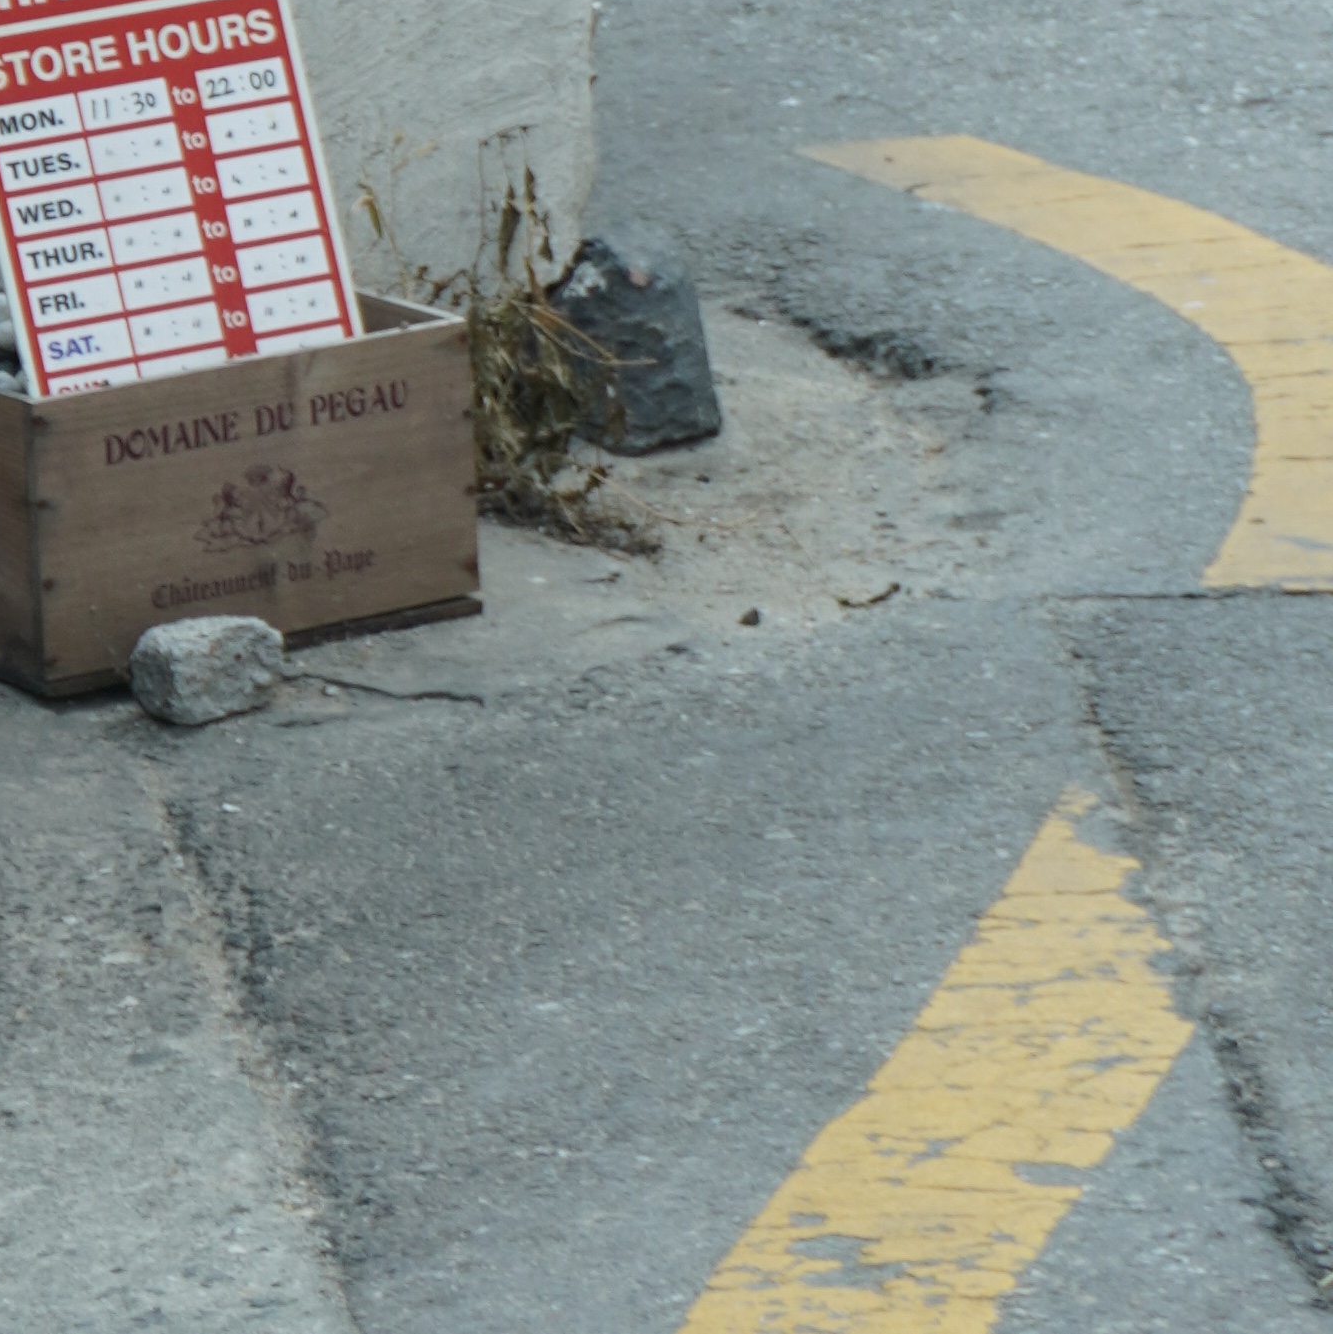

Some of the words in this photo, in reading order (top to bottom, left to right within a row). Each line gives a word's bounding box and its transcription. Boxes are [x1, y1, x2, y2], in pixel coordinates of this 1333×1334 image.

[125, 8, 278, 66] HOURS
[172, 85, 196, 105] to
[6, 151, 81, 180] TUES.
[182, 130, 206, 150] to
[16, 199, 83, 225] WED.
[192, 174, 216, 194] to
[26, 241, 104, 270] THUR.
[202, 219, 226, 239] to
[37, 291, 86, 316] FRI.
[212, 263, 236, 283] to
[47, 334, 101, 360] SAT.
[222, 308, 247, 328] to
[104, 411, 240, 465] DOMAINE
[254, 401, 296, 436] DU
[309, 379, 410, 426] PEGAU
